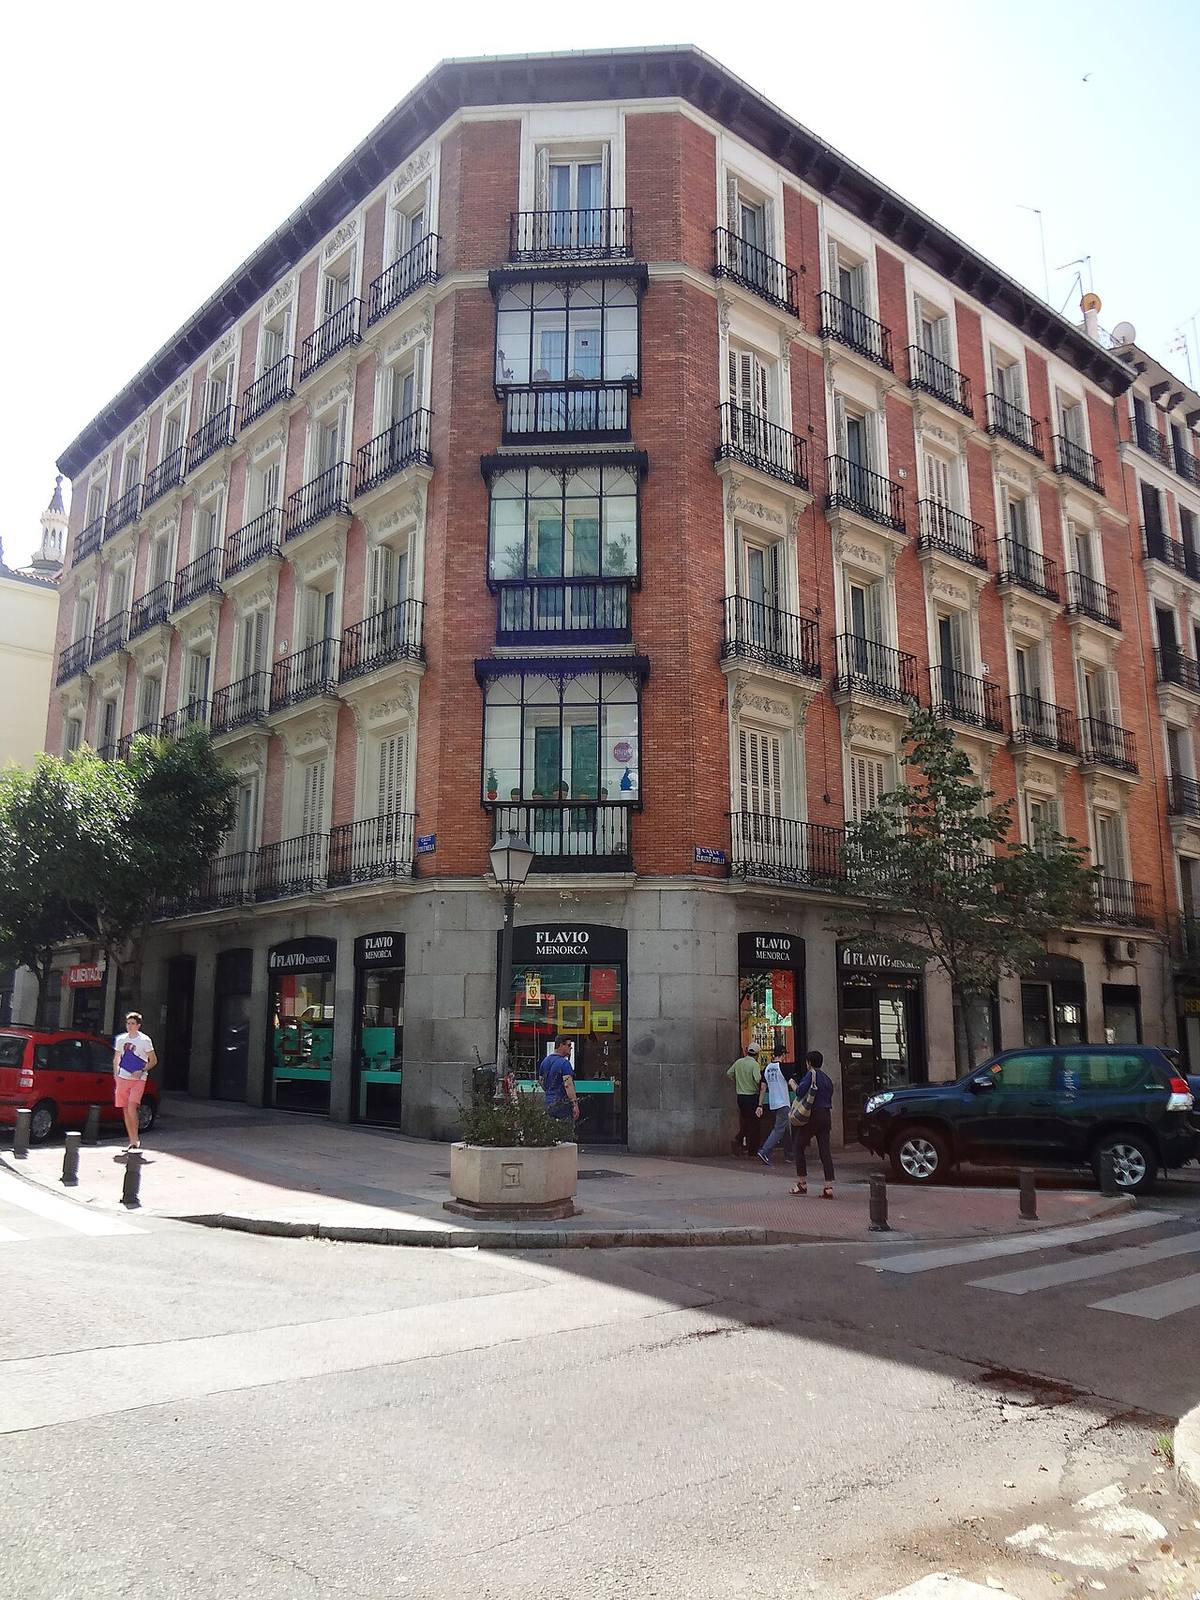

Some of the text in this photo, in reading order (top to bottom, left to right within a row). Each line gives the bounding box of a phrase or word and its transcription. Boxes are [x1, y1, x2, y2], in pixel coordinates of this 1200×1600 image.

[701, 848, 720, 856] CALLE
[365, 936, 393, 949] FLAVIO
[536, 931, 590, 943] FLAVIO
[755, 936, 791, 950] FLAVIO
[365, 949, 393, 960] MENORCA
[536, 945, 588, 955] MENORCA
[755, 950, 790, 961] MENORCA
[276, 953, 305, 967] FLAVIO
